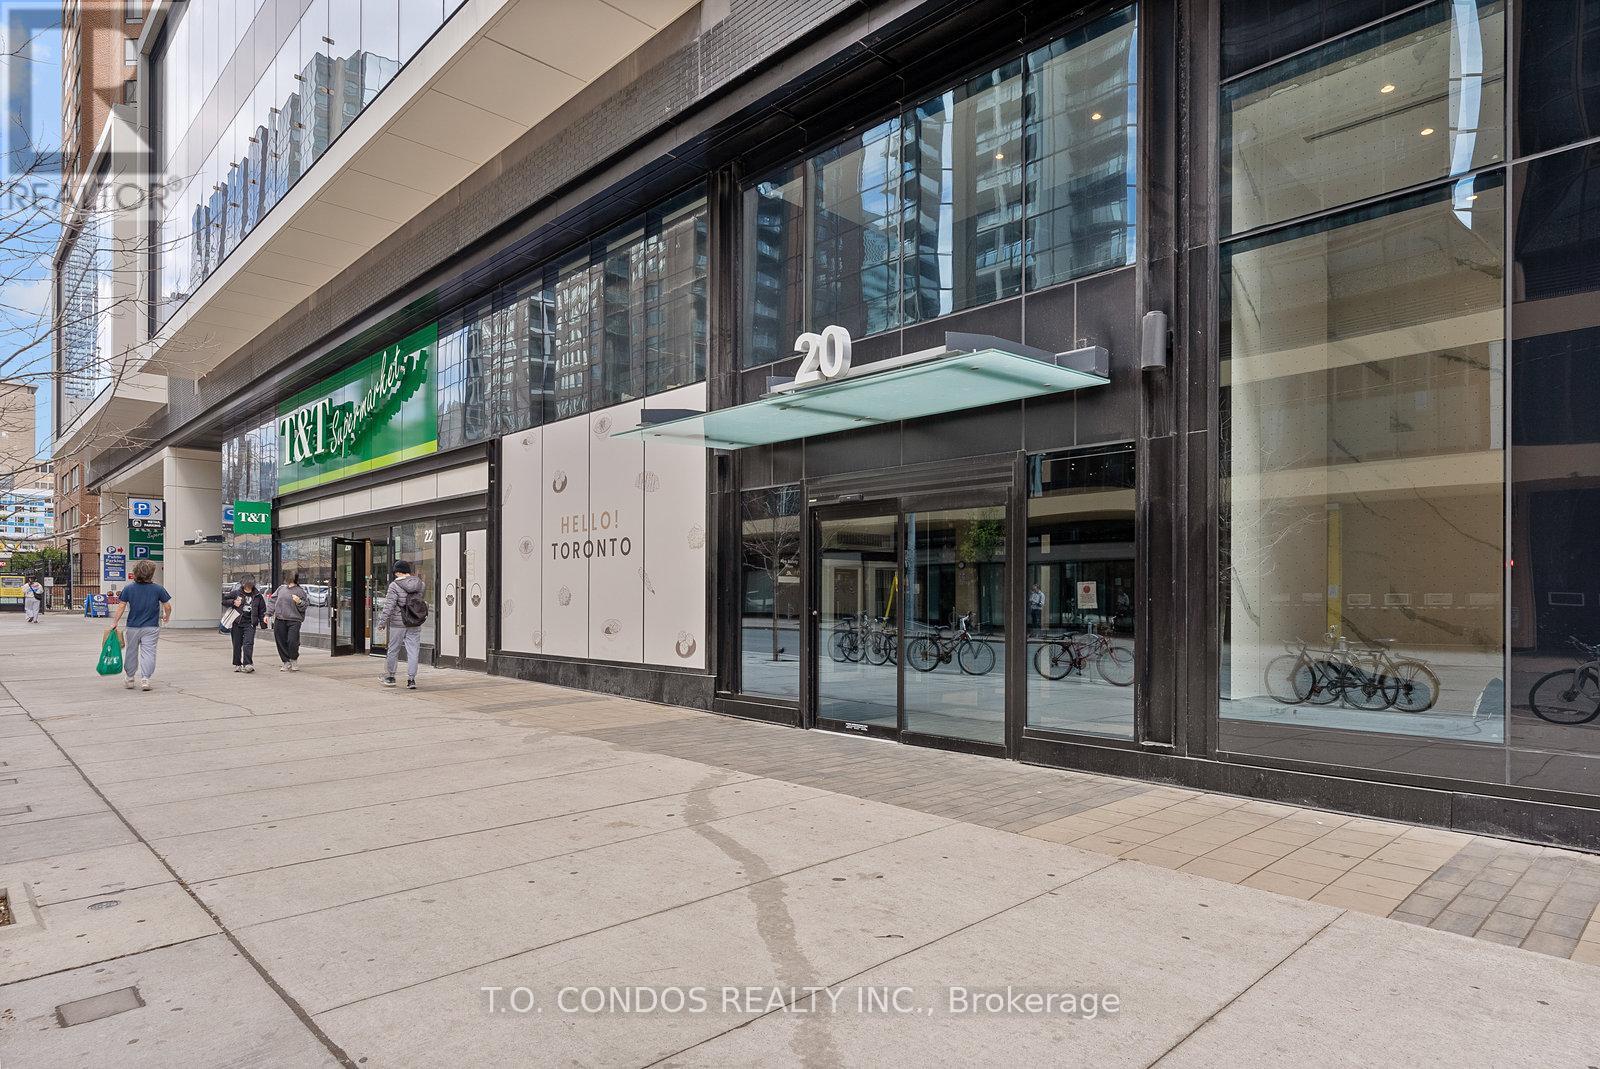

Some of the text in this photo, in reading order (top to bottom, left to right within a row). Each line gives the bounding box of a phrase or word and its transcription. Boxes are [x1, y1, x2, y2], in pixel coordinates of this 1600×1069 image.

[794, 325, 852, 384] 20
[280, 345, 401, 466] T&T Supermarket
[238, 512, 269, 523] T&T
[561, 510, 618, 534] HELLO!
[424, 530, 433, 542] 22
[551, 537, 631, 560] TORONTO
